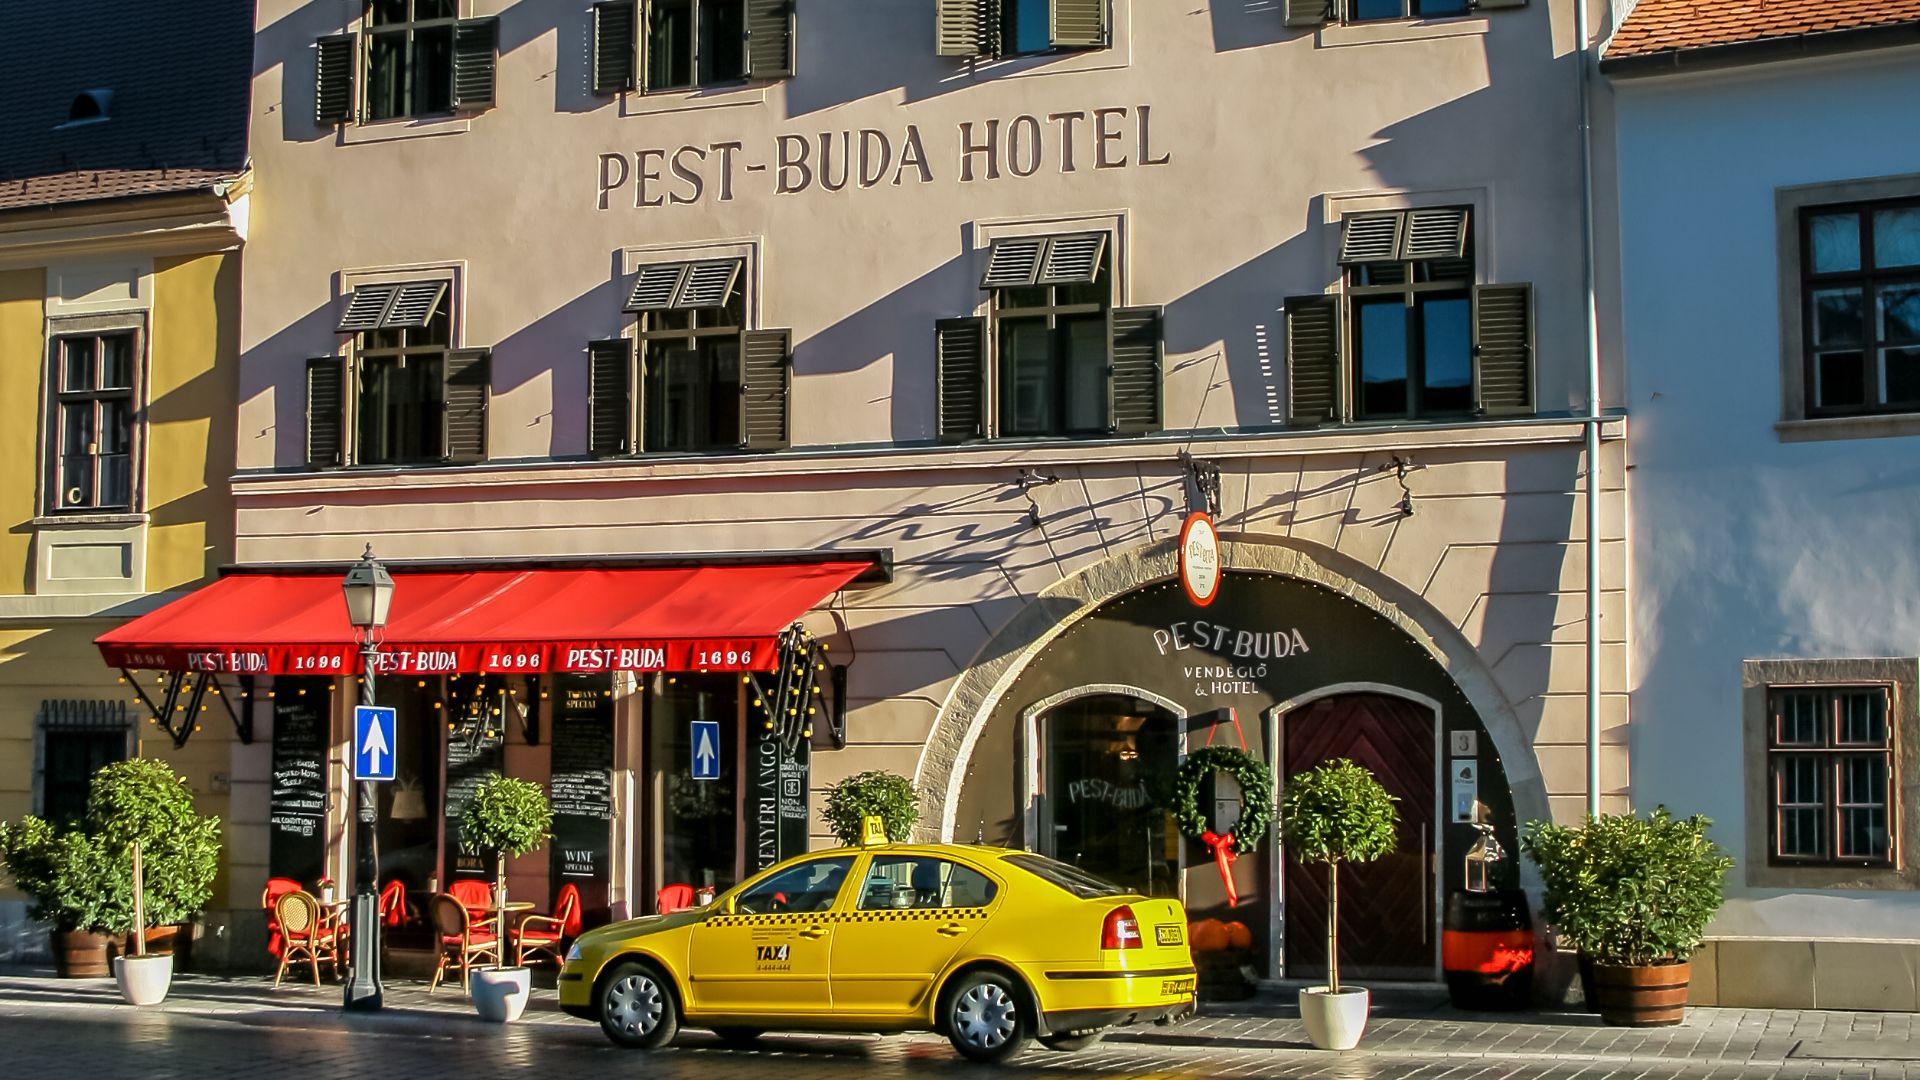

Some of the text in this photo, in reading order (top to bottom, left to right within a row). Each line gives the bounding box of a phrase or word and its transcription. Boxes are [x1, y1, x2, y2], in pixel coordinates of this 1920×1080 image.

[597, 105, 1172, 211] PEST-BUDA HOTEL
[124, 653, 166, 666] 1696
[295, 655, 341, 669] 1696
[489, 654, 540, 668] 1696
[698, 651, 751, 665] 1696
[1211, 681, 1259, 694] HOTEL
[1459, 734, 1469, 752] 3
[565, 850, 594, 863] WINE
